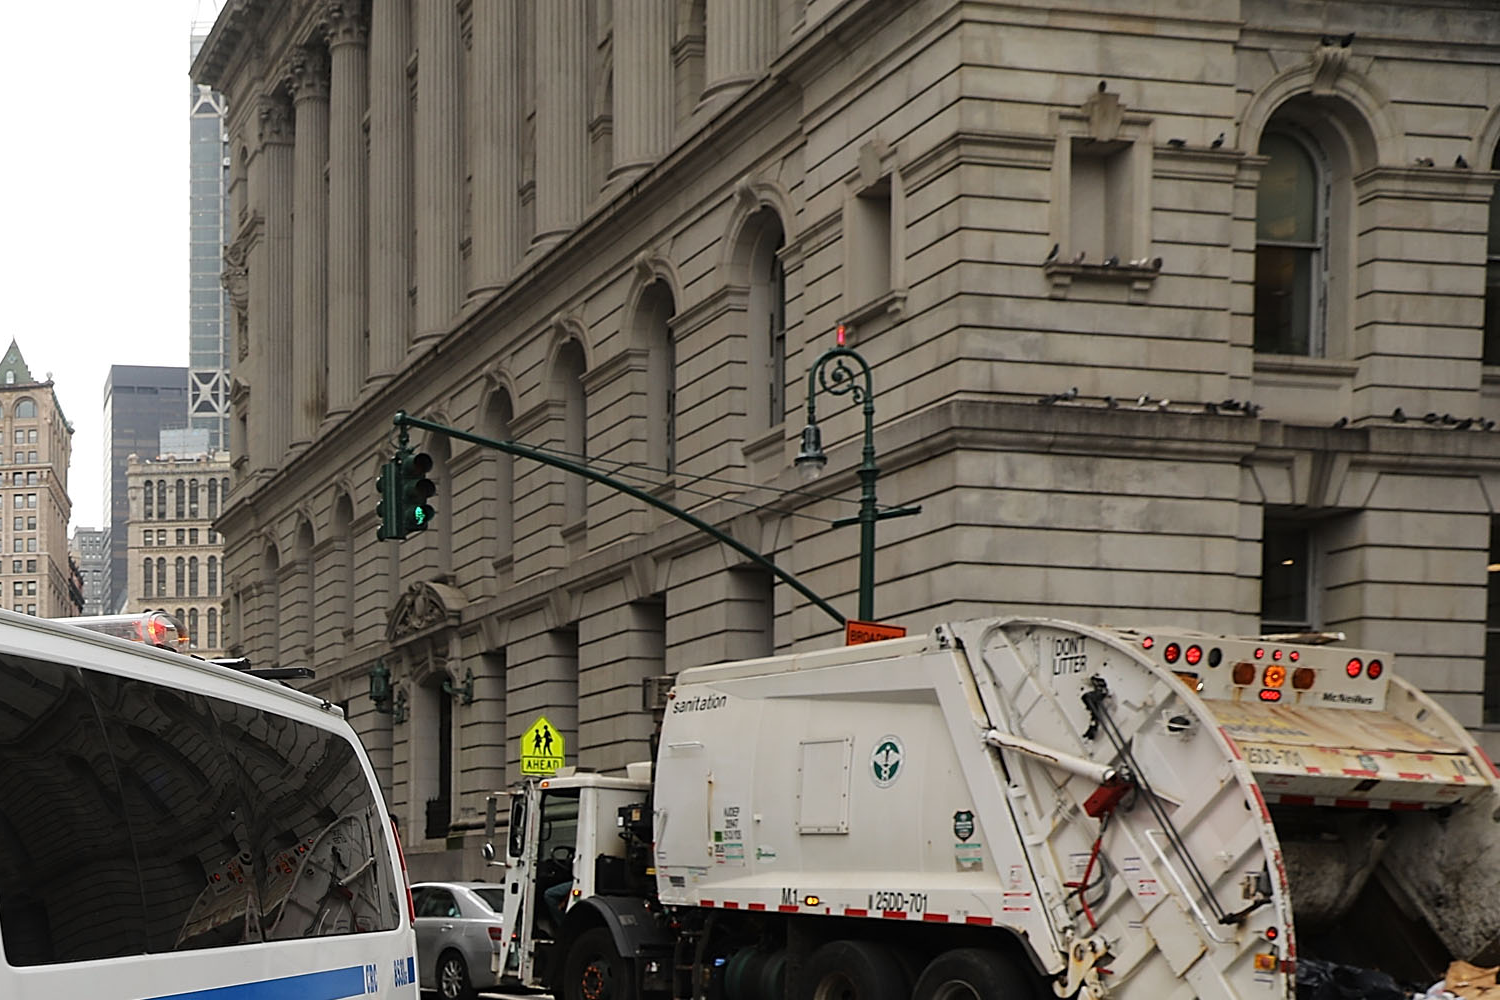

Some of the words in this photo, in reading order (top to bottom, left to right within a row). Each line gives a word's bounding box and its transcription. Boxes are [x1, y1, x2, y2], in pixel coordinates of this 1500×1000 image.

[1055, 635, 1086, 656] DON'T
[1053, 655, 1087, 675] LITTER
[673, 694, 727, 713] sanitation
[526, 760, 559, 770] AHEAD
